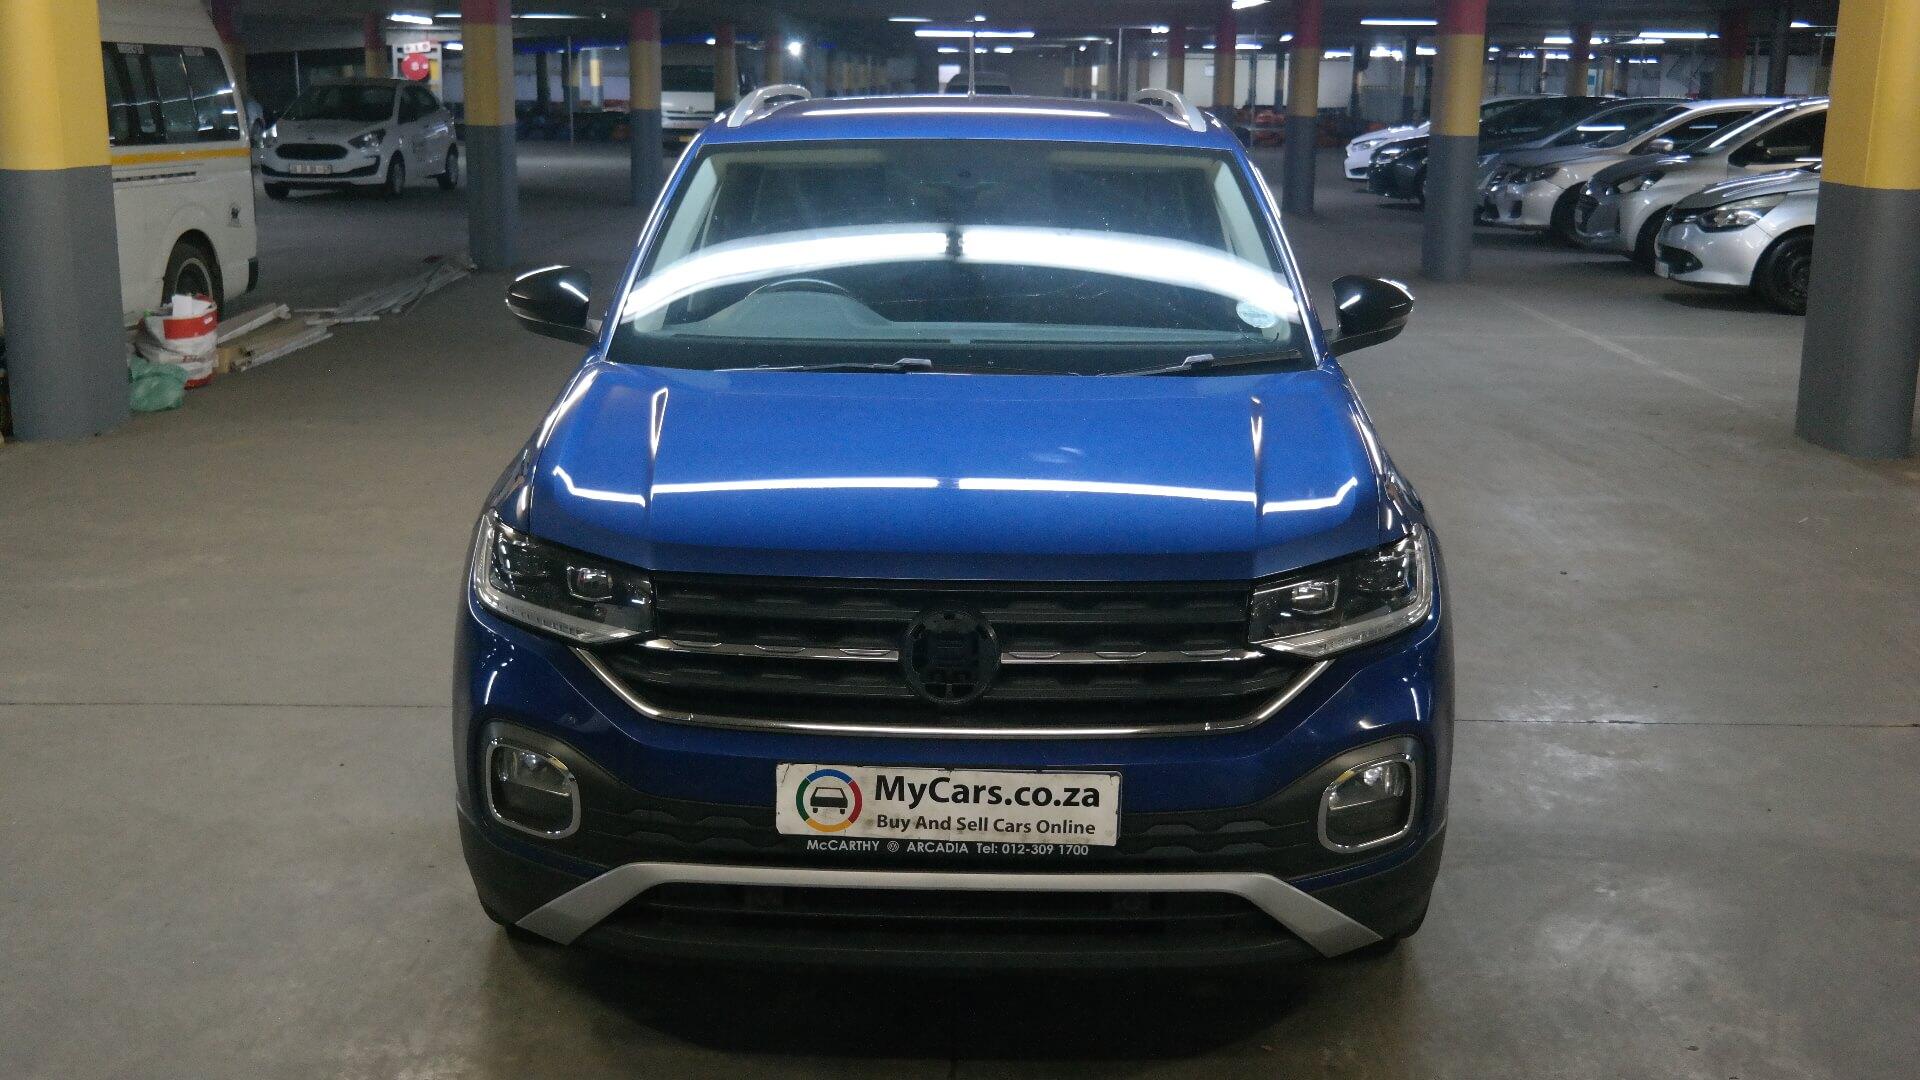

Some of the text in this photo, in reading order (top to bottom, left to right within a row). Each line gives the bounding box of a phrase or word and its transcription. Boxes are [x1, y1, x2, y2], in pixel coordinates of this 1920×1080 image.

[874, 774, 1100, 809] MyCars.co.za
[876, 813, 1096, 835] Buy And Sell Cars Online
[806, 839, 880, 851] McCARTHY
[906, 841, 969, 853] ARCADIA
[976, 842, 998, 854] Tel:
[1001, 843, 1054, 855] 012-309
[1059, 844, 1089, 856] 1700
